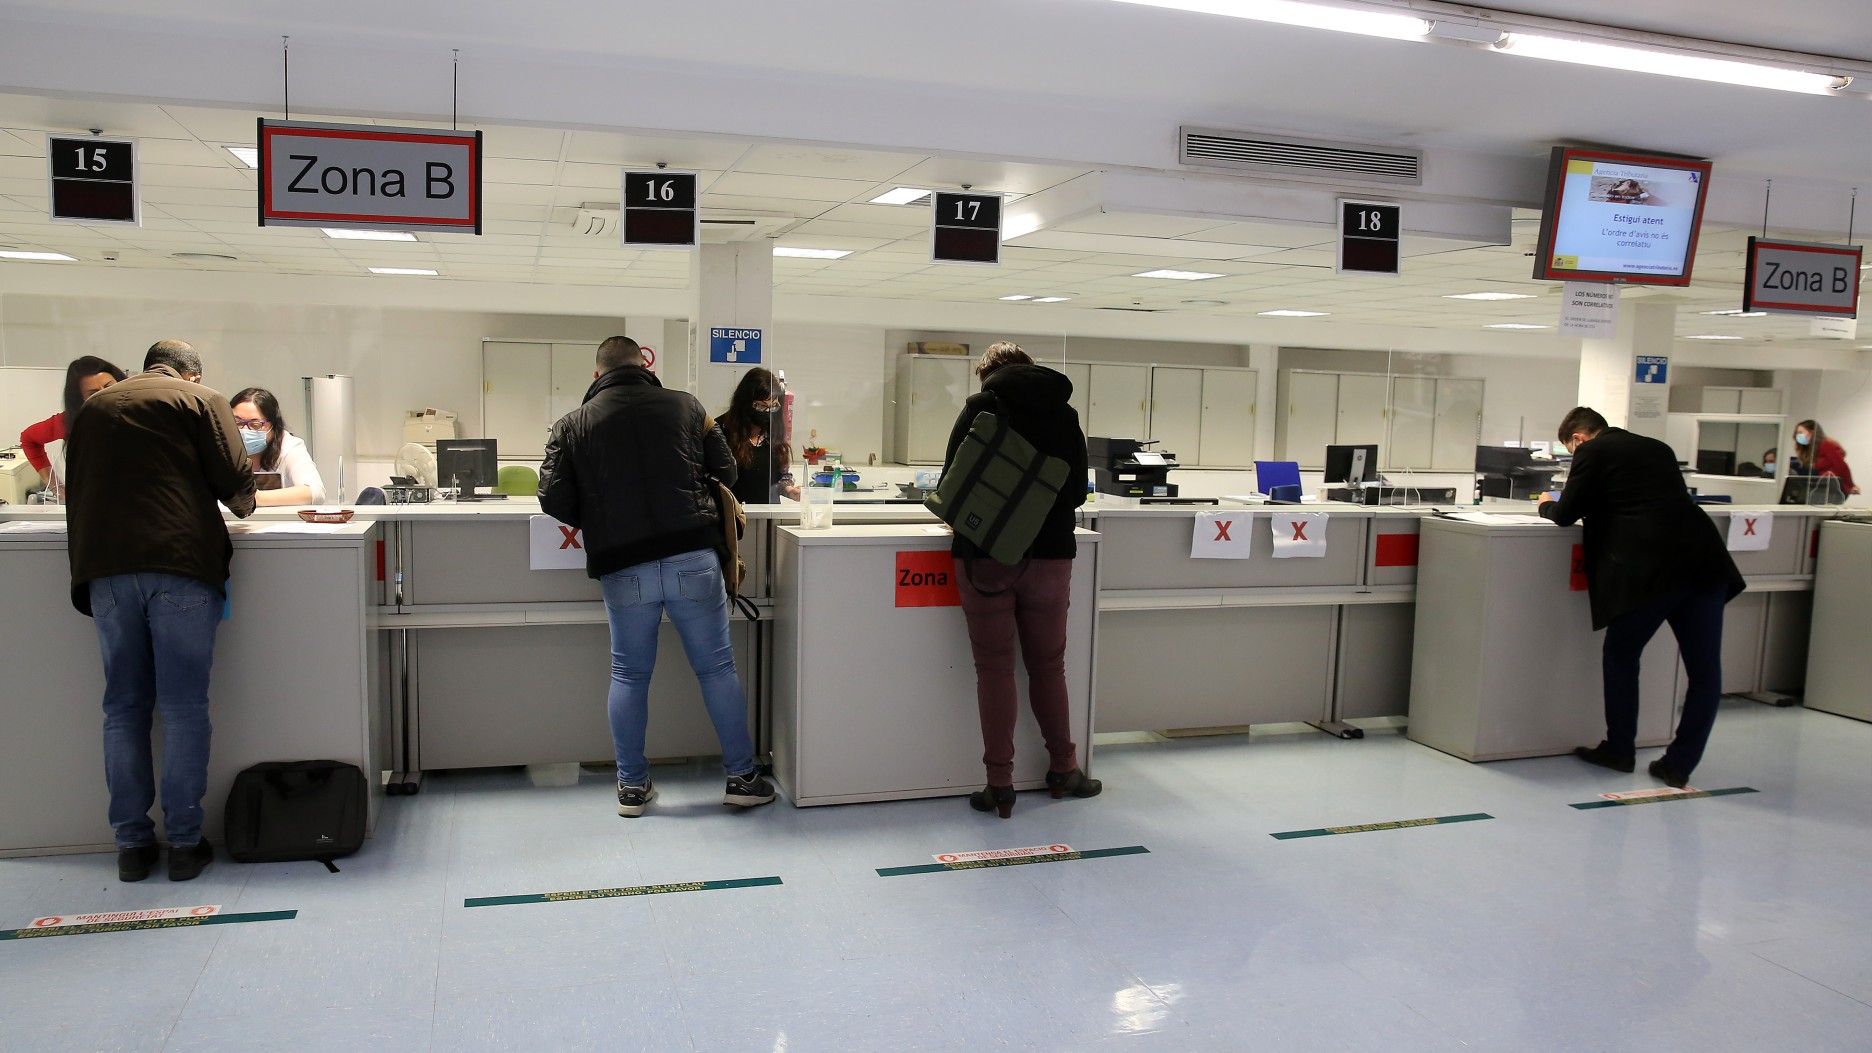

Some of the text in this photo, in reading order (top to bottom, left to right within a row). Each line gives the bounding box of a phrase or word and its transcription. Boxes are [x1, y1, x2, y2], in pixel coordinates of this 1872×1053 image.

[75, 147, 107, 171] 15
[287, 154, 455, 199] Zona B
[646, 180, 674, 201] 16
[955, 201, 981, 220] 17
[1358, 210, 1381, 231] 18
[1614, 214, 1664, 226] Estigui atent
[1601, 228, 1627, 237] L'ordre
[1763, 262, 1848, 293] Zona B
[712, 329, 760, 339] SILENCIO
[1214, 520, 1232, 541] X
[1291, 521, 1308, 541] X
[1744, 518, 1757, 536] X
[558, 526, 582, 549] X
[899, 569, 948, 586] Zona
